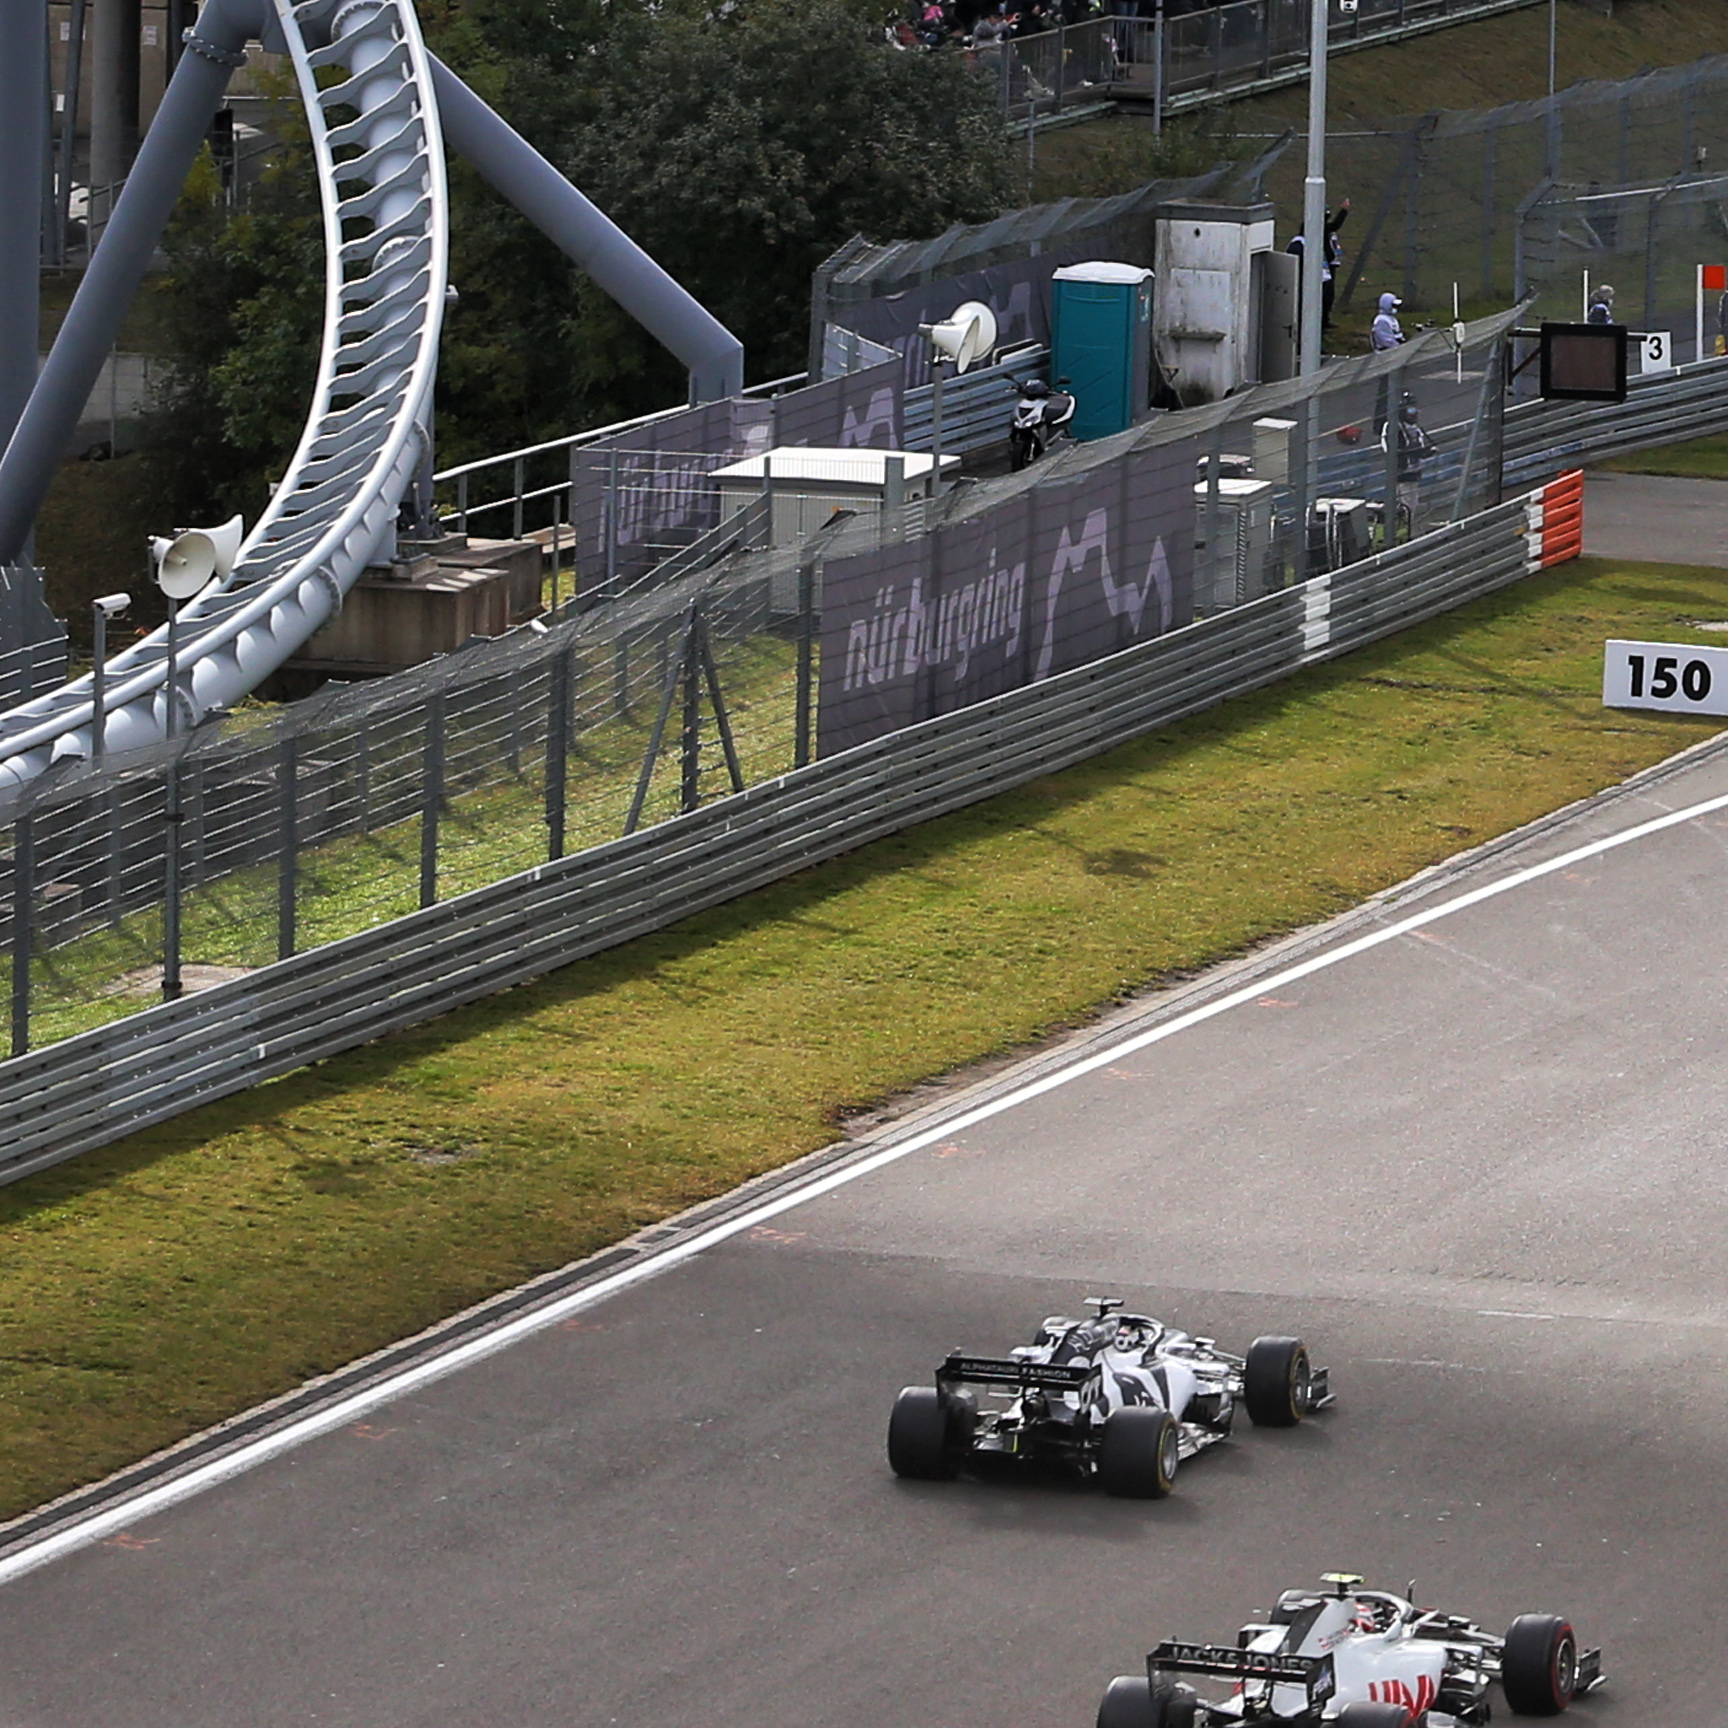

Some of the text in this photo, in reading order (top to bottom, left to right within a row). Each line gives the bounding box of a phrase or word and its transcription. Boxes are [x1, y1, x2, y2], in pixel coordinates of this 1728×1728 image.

[1649, 336, 1663, 360] 3
[843, 547, 1027, 692] nürburgring
[1628, 655, 1711, 701] 150
[1021, 1367, 1071, 1379] FASHION
[1170, 1645, 1222, 1663] JACK
[1246, 1653, 1315, 1672] JONES
